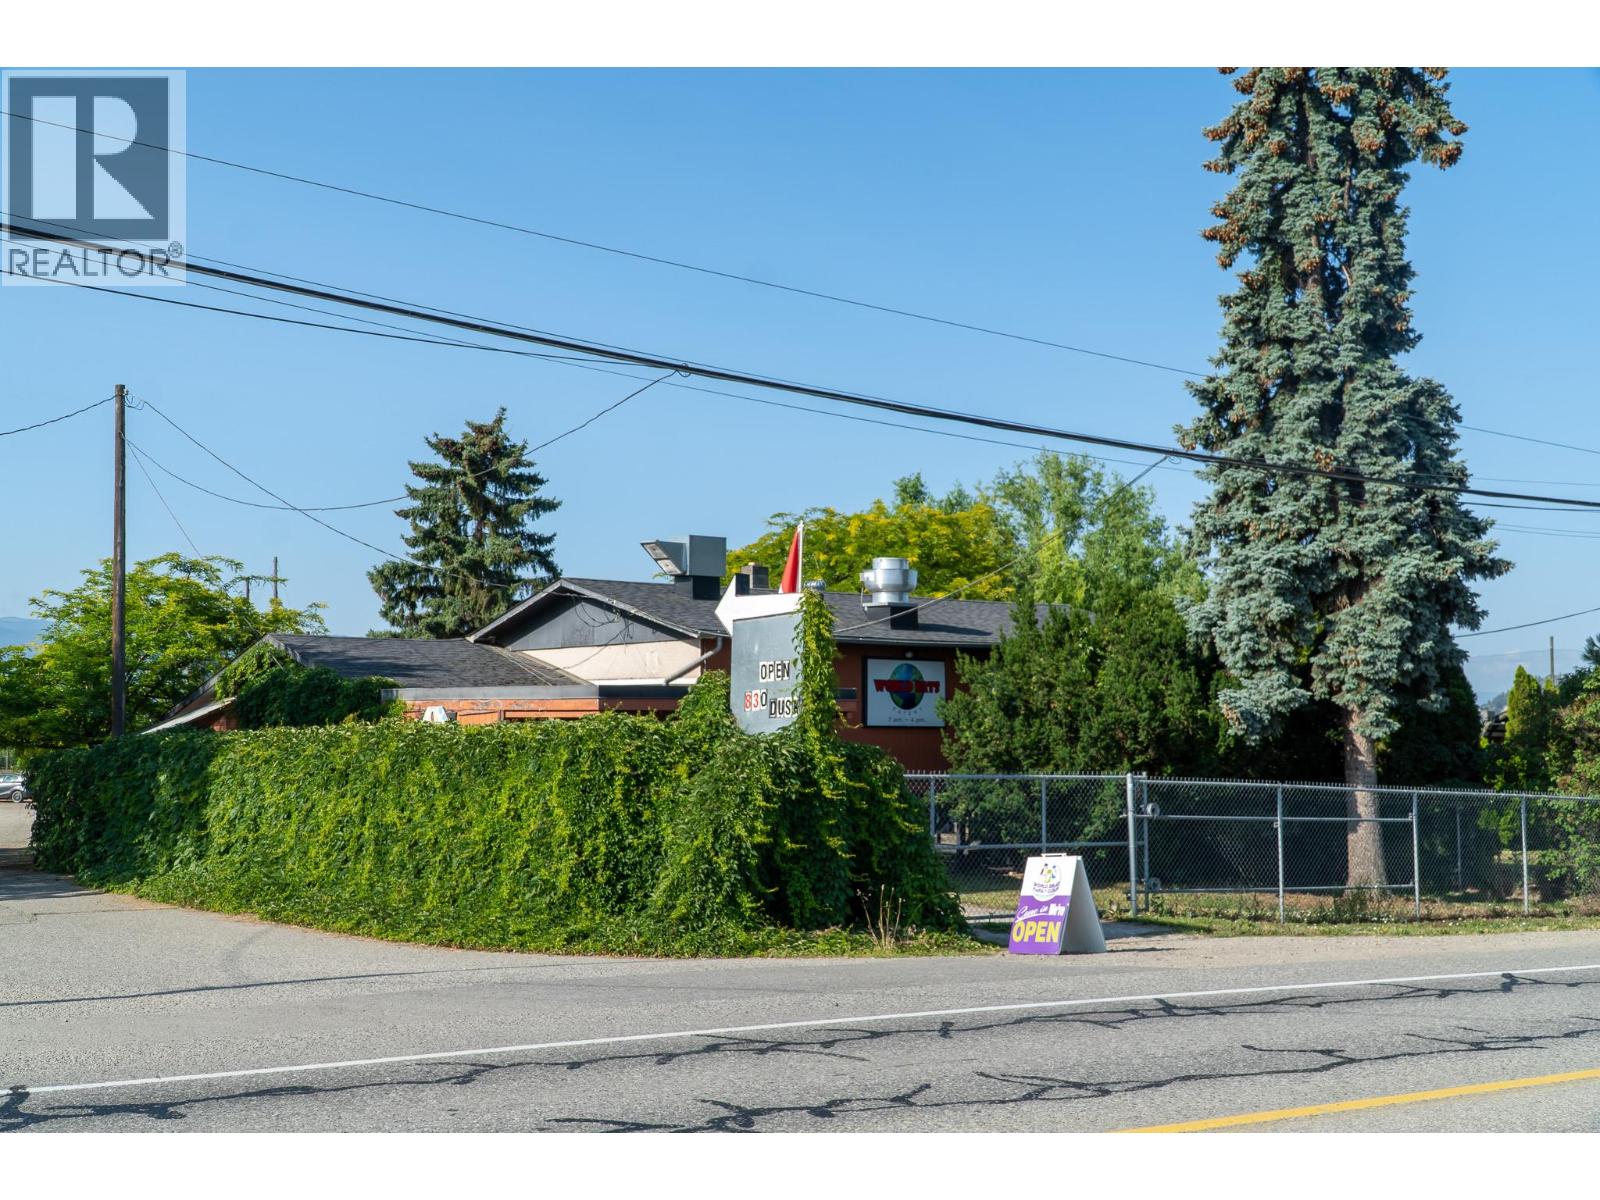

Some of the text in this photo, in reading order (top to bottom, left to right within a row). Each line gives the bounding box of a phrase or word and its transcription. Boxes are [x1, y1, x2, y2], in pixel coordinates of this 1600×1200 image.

[760, 661, 790, 680] OPEN
[744, 690, 768, 710] 830
[1012, 921, 1061, 943] OPEN
